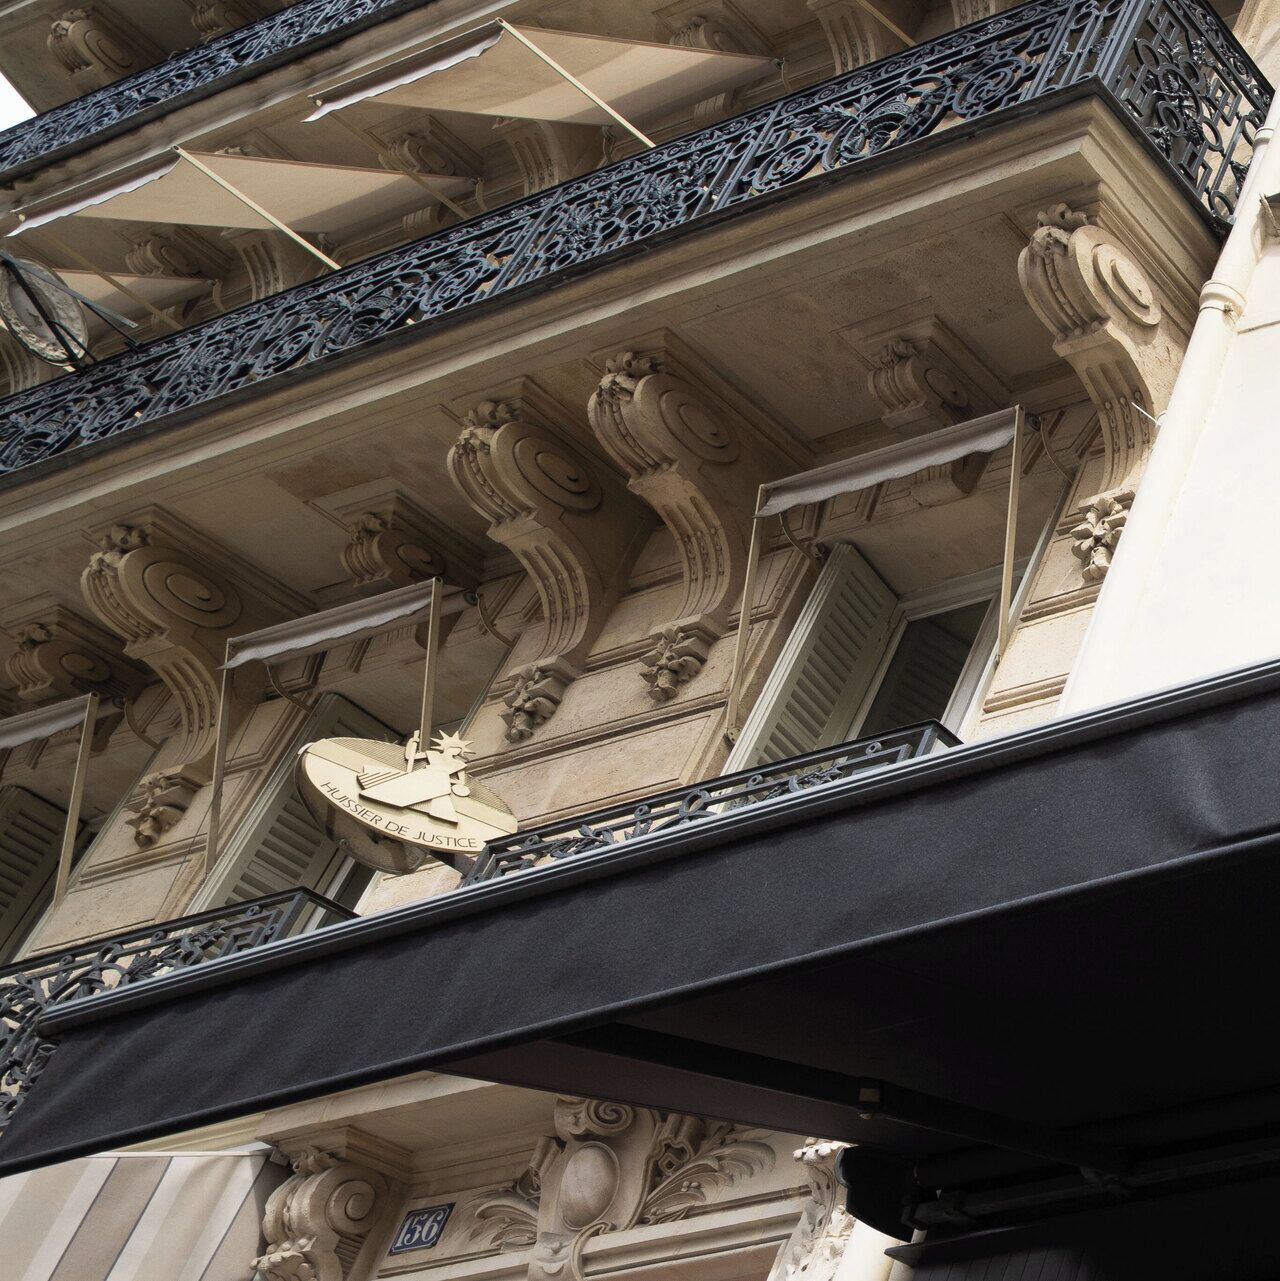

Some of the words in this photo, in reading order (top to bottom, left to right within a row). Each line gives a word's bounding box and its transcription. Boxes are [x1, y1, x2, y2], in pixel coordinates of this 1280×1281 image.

[320, 781, 383, 826] HUISSIER
[384, 820, 411, 836] DE
[412, 830, 478, 848] JUSTICE
[394, 1210, 444, 1248] 156
